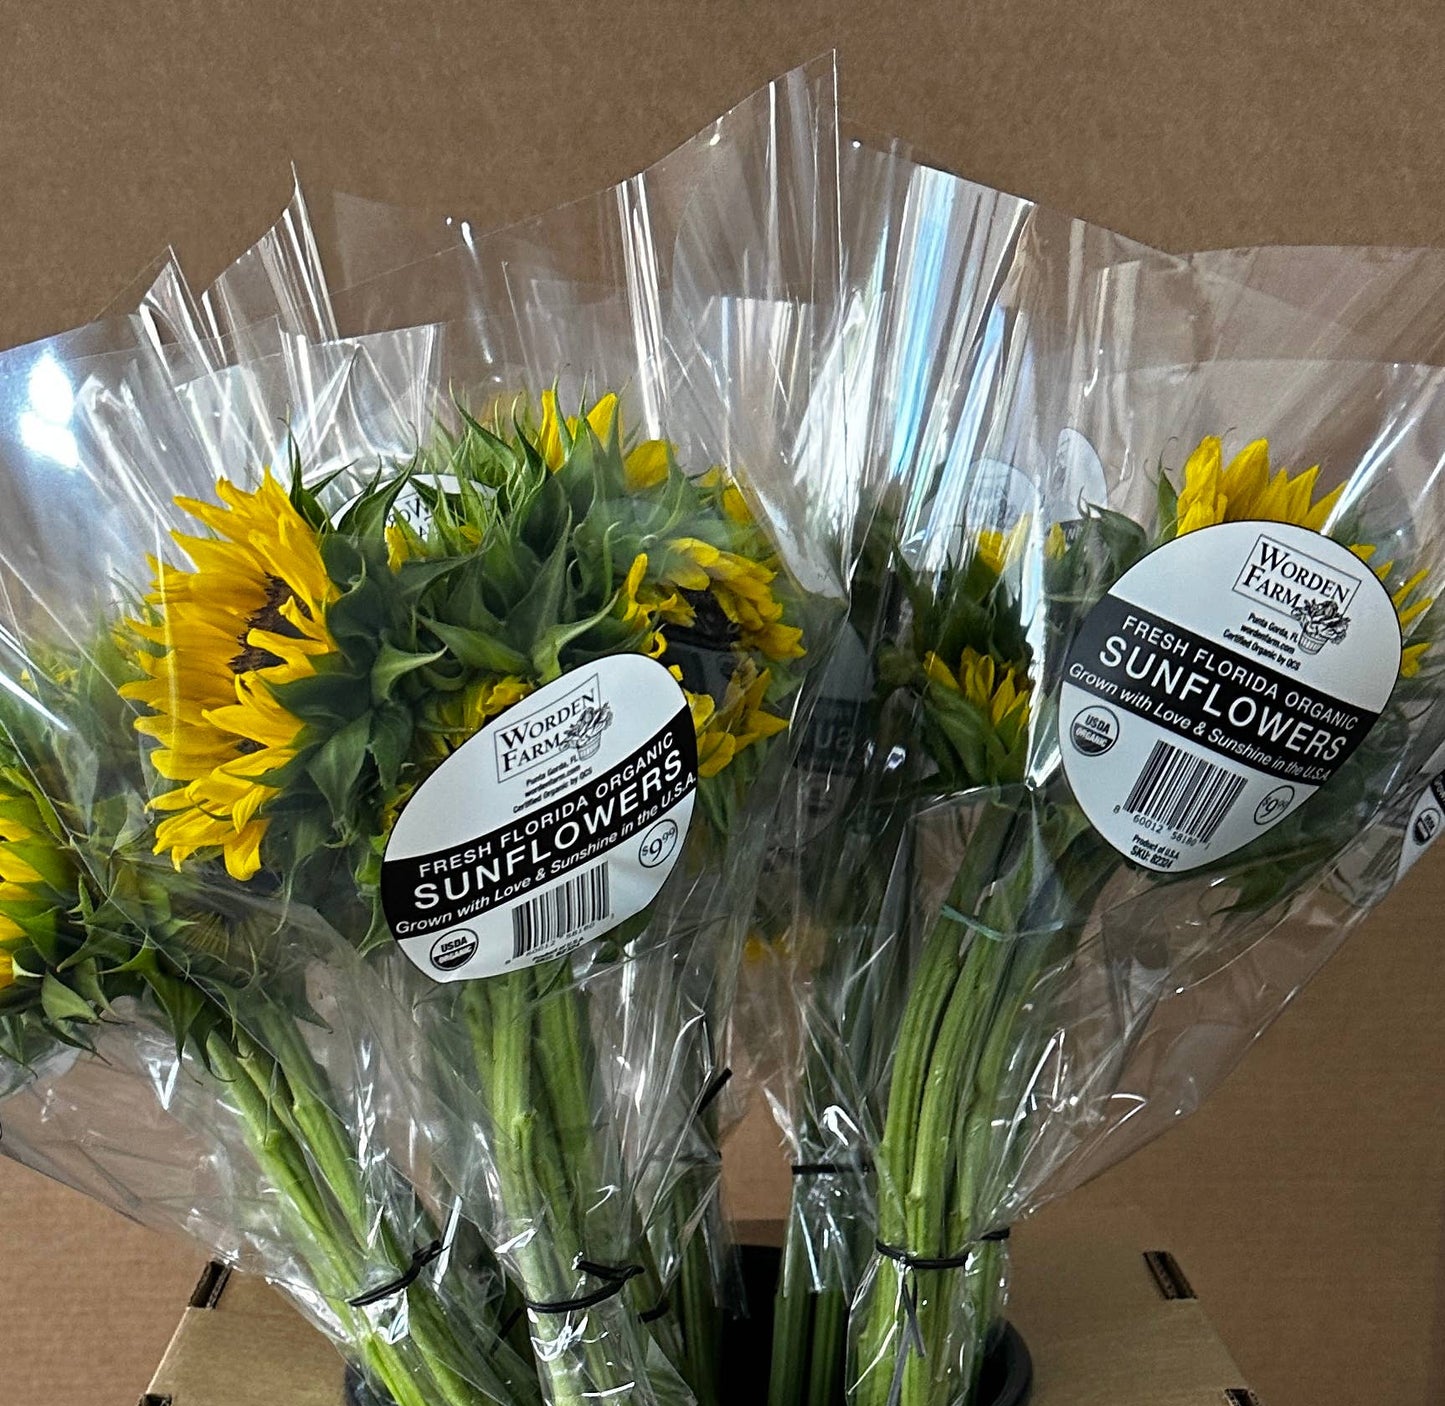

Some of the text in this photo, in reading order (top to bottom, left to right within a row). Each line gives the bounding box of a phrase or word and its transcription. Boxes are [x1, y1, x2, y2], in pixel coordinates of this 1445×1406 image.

[1242, 564, 1302, 609] FARM
[1261, 542, 1350, 603] WORDEN
[1223, 629, 1251, 648] Certified
[1251, 641, 1277, 661] Organic
[1277, 652, 1286, 665] by
[1240, 624, 1295, 654] wordenfarm.com
[1248, 612, 1269, 628] Punta
[1268, 622, 1289, 640] Gorda,
[1122, 615, 1359, 730] FRESH FLORIDA ORGANIC
[500, 687, 595, 749] WORDEN
[1069, 662, 1119, 695] Grown
[1119, 687, 1152, 712] with
[1153, 702, 1192, 730] Love
[1193, 721, 1206, 736] &
[1208, 727, 1272, 766] Sunshine
[1271, 755, 1286, 771] in
[1284, 761, 1300, 776] the
[1100, 635, 1347, 761] SUNFLOWERS
[1075, 727, 1108, 748] ORGANIC
[1085, 714, 1111, 735] USDA
[502, 732, 562, 772] FARM
[419, 732, 673, 878] FRESH FLORIDA ORGANIC
[1133, 814, 1164, 834] 60012
[414, 750, 682, 909] SUNFLOWERS
[1132, 834, 1159, 852] Product
[396, 772, 697, 934] Grown with Love & Sunshine in the U.S.A.
[441, 936, 468, 952] USDA
